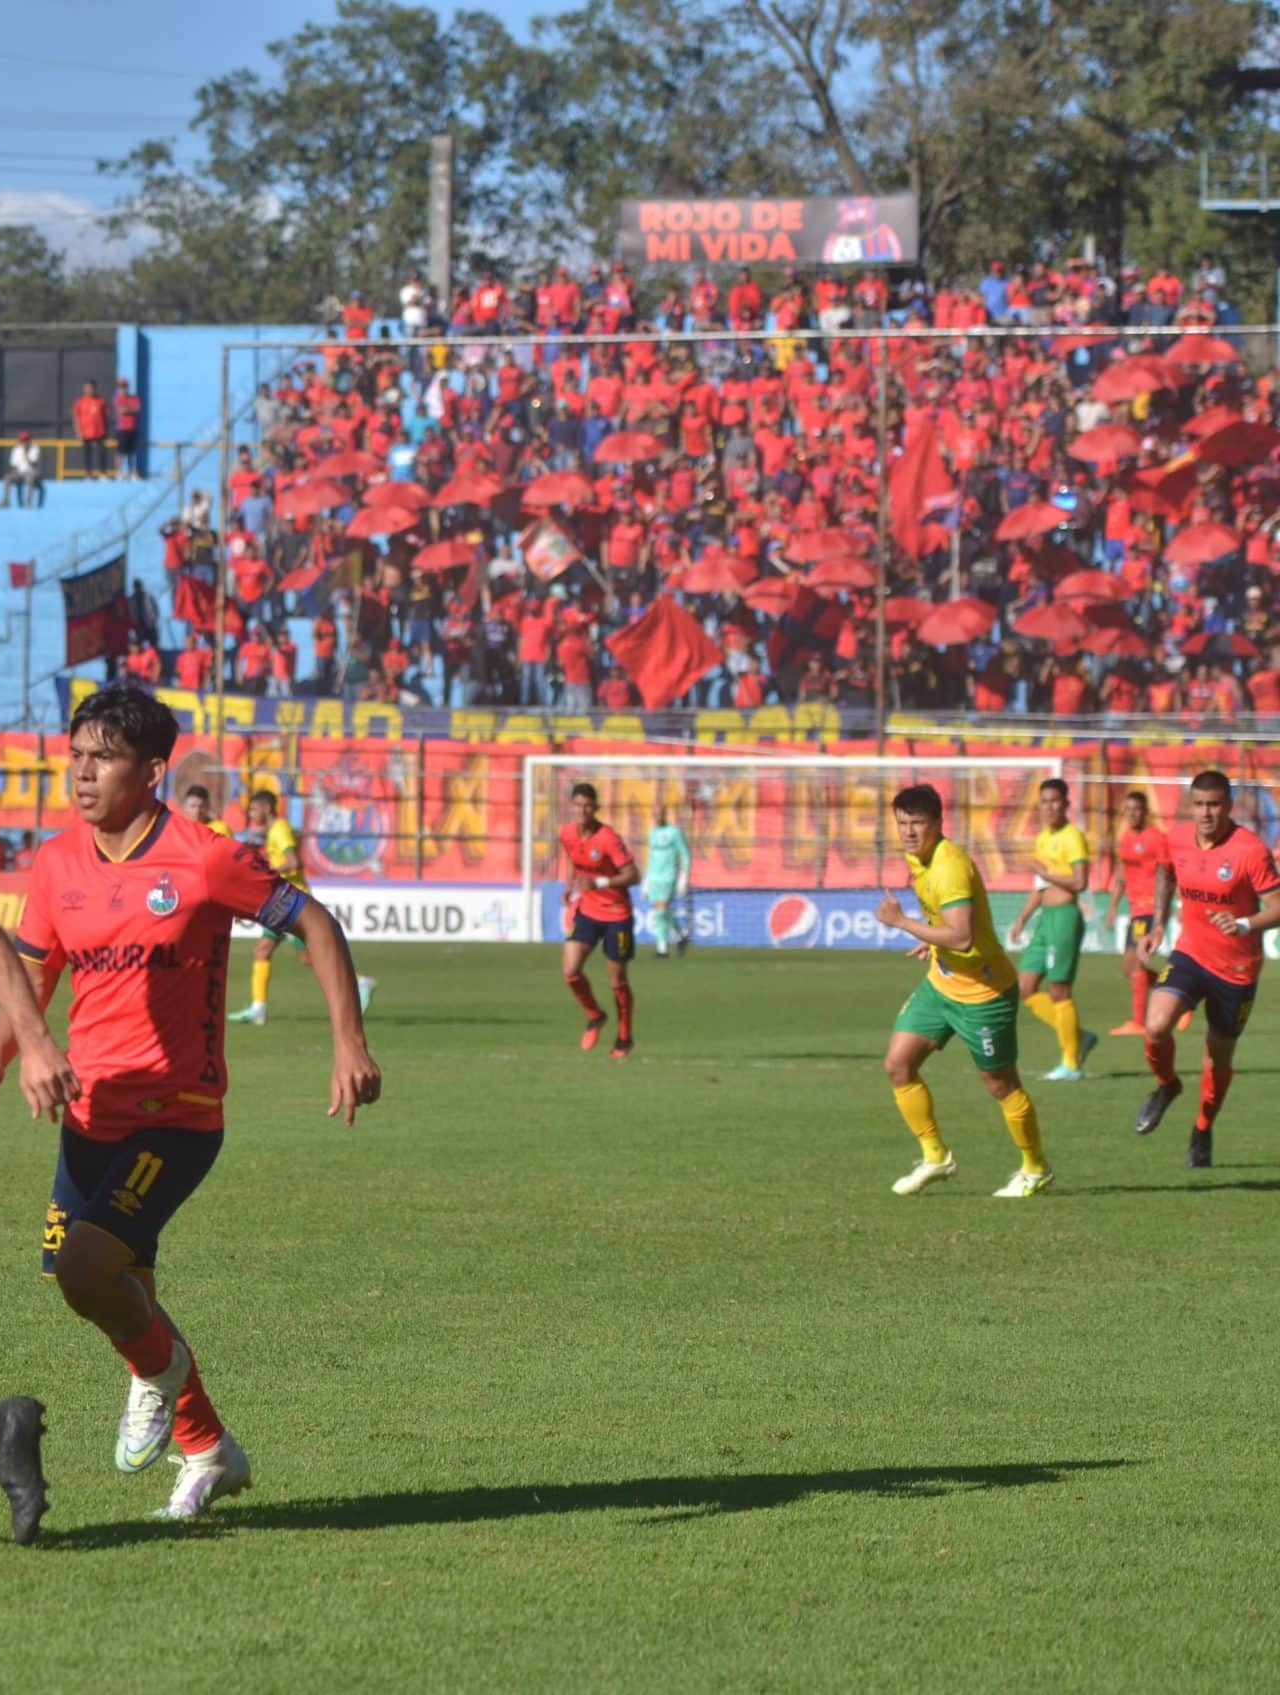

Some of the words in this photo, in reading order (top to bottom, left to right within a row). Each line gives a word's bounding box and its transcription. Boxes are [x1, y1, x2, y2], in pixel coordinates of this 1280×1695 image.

[638, 202, 741, 232] ROJO
[751, 202, 804, 231] DE
[646, 232, 691, 262] MI
[700, 232, 798, 262] VIDA
[363, 903, 465, 934] SALUD
[982, 1038, 995, 1058] 5
[124, 1150, 165, 1198] 11
